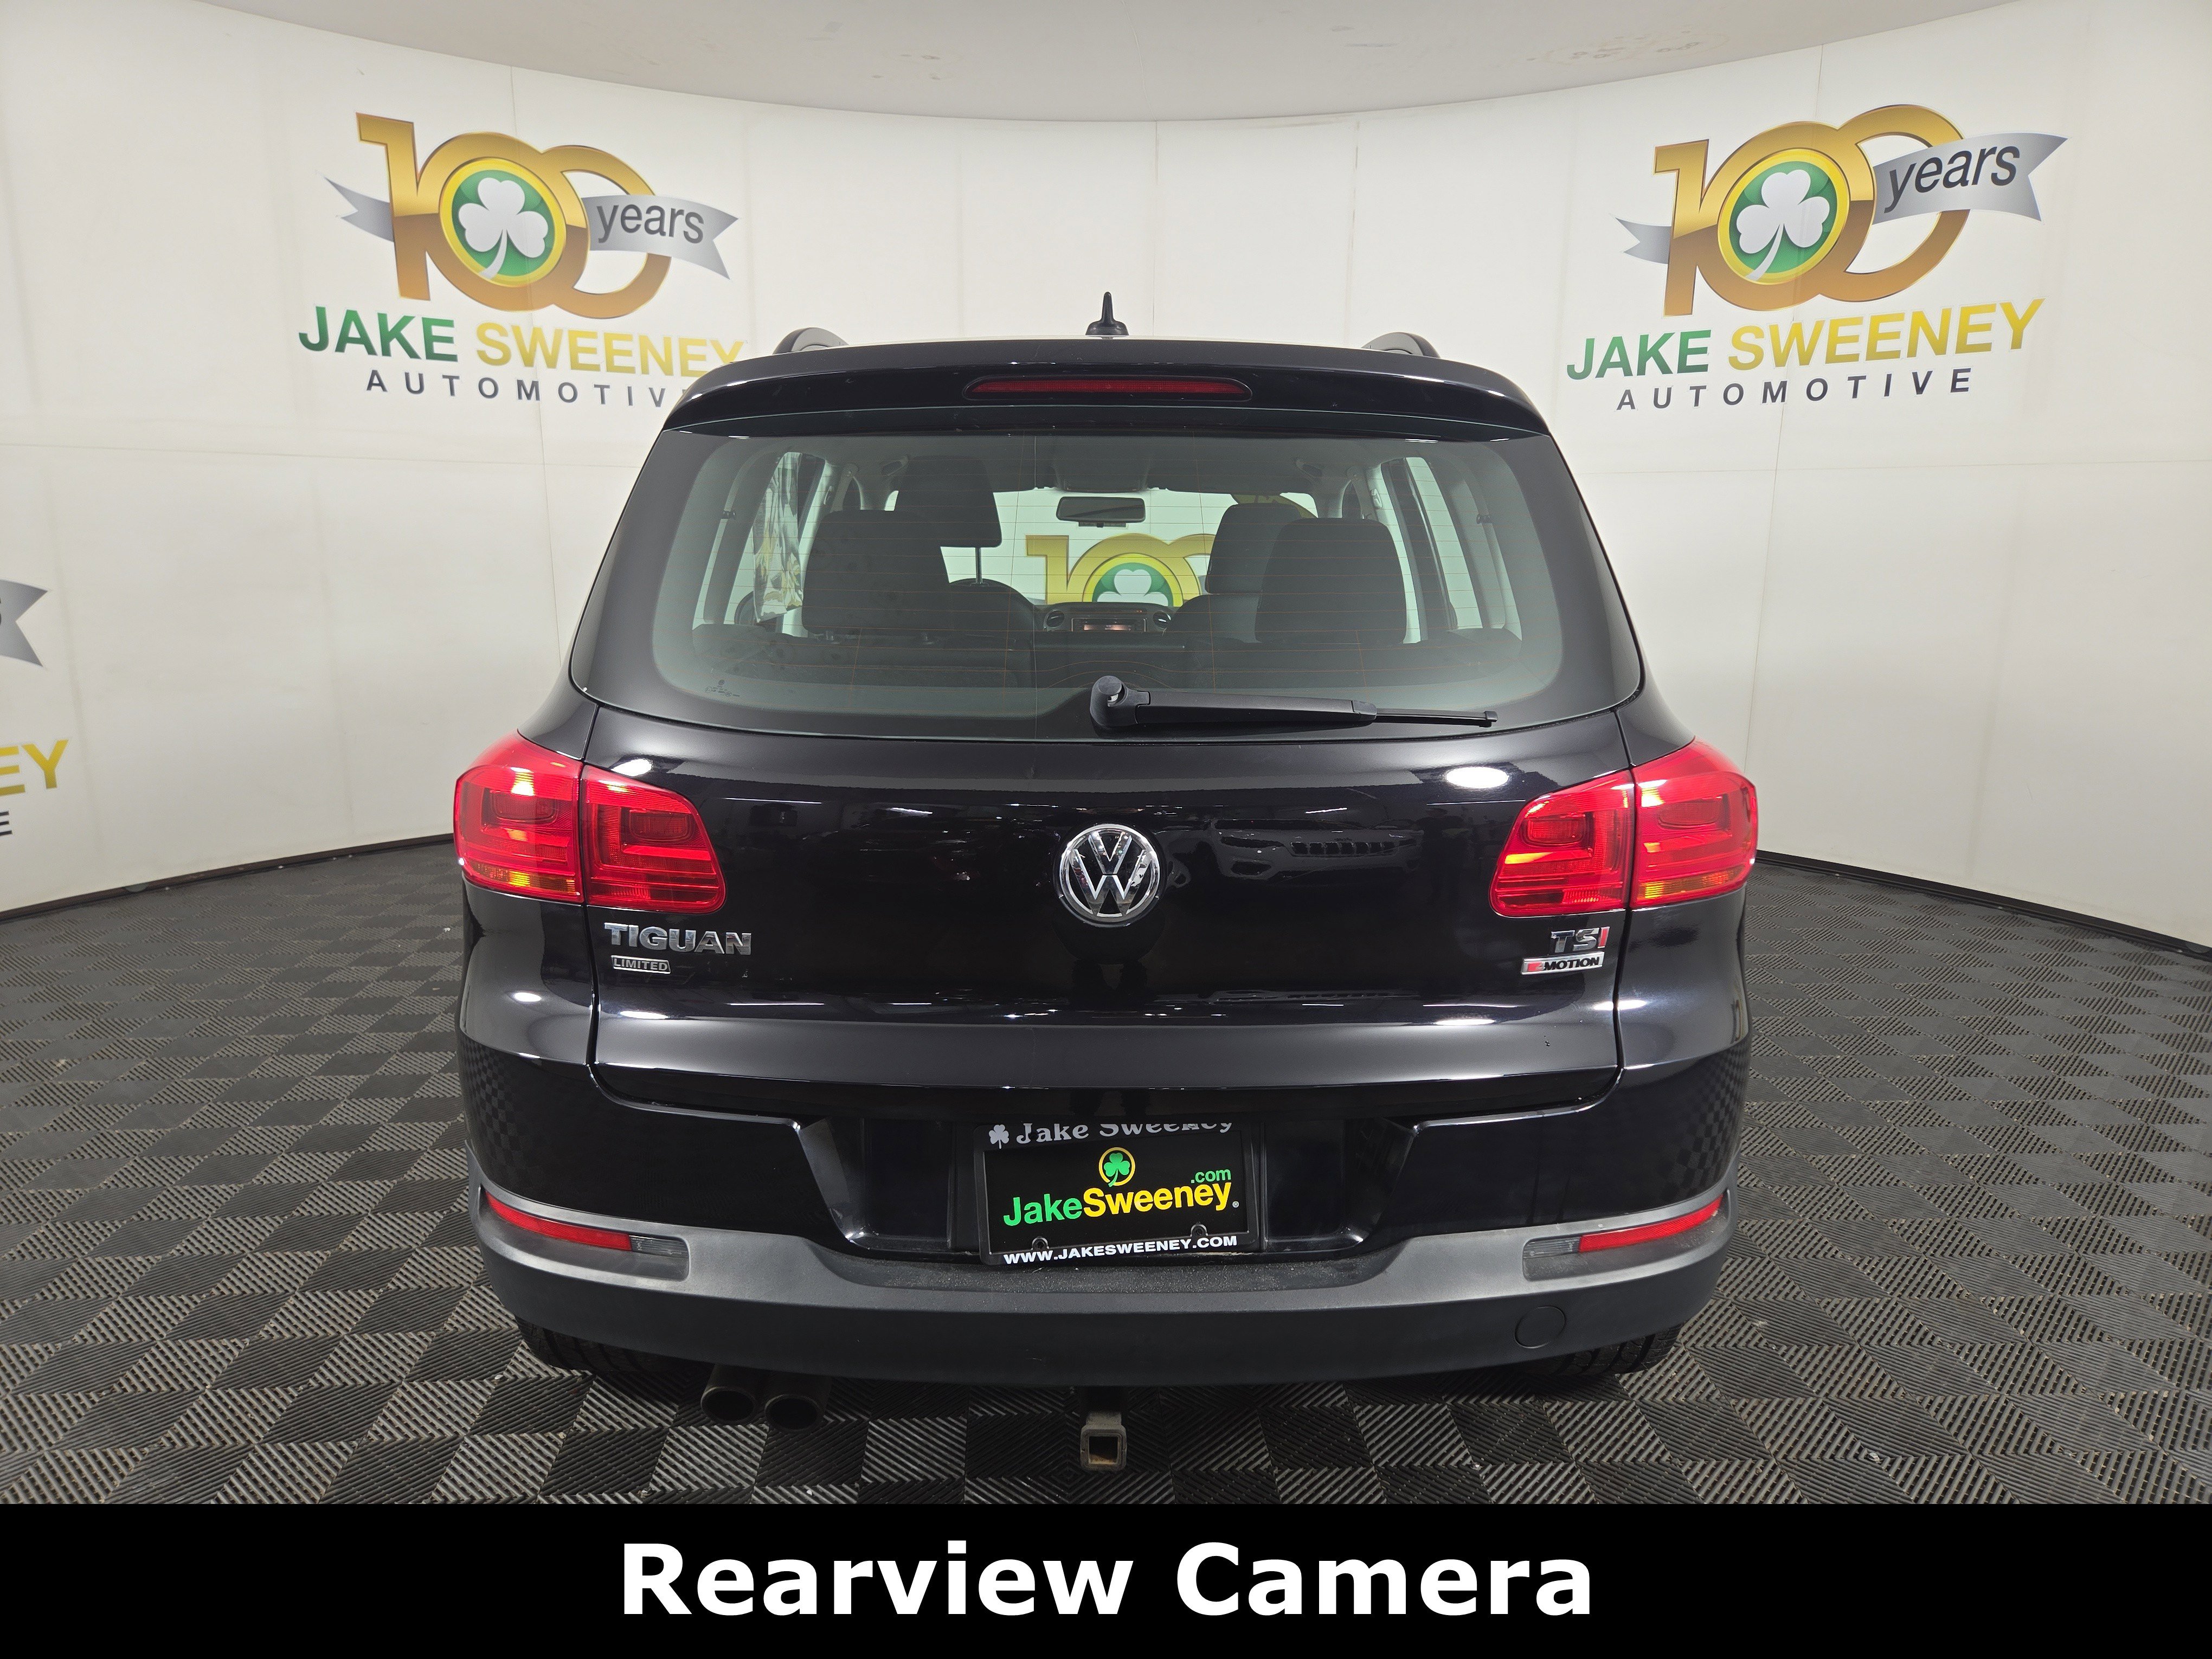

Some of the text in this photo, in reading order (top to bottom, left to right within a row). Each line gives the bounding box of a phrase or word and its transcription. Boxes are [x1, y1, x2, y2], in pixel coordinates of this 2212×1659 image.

[1884, 145, 2021, 214] years
[596, 202, 705, 245] years
[298, 306, 744, 377] JAKE SWEENEY
[1566, 298, 2046, 381] JAKE SWEENEY
[366, 370, 685, 408] AUTOMOTIV
[1616, 368, 1972, 410] AUTOMOTIVE
[604, 922, 752, 955] TIGUAN
[1551, 927, 1610, 953] TSI
[613, 958, 669, 972] LIMITED
[1016, 1123, 1089, 1144] Jake
[1191, 1168, 1231, 1184] .com
[1003, 1236, 1237, 1265] WWW.JAKESWEENEY.COM
